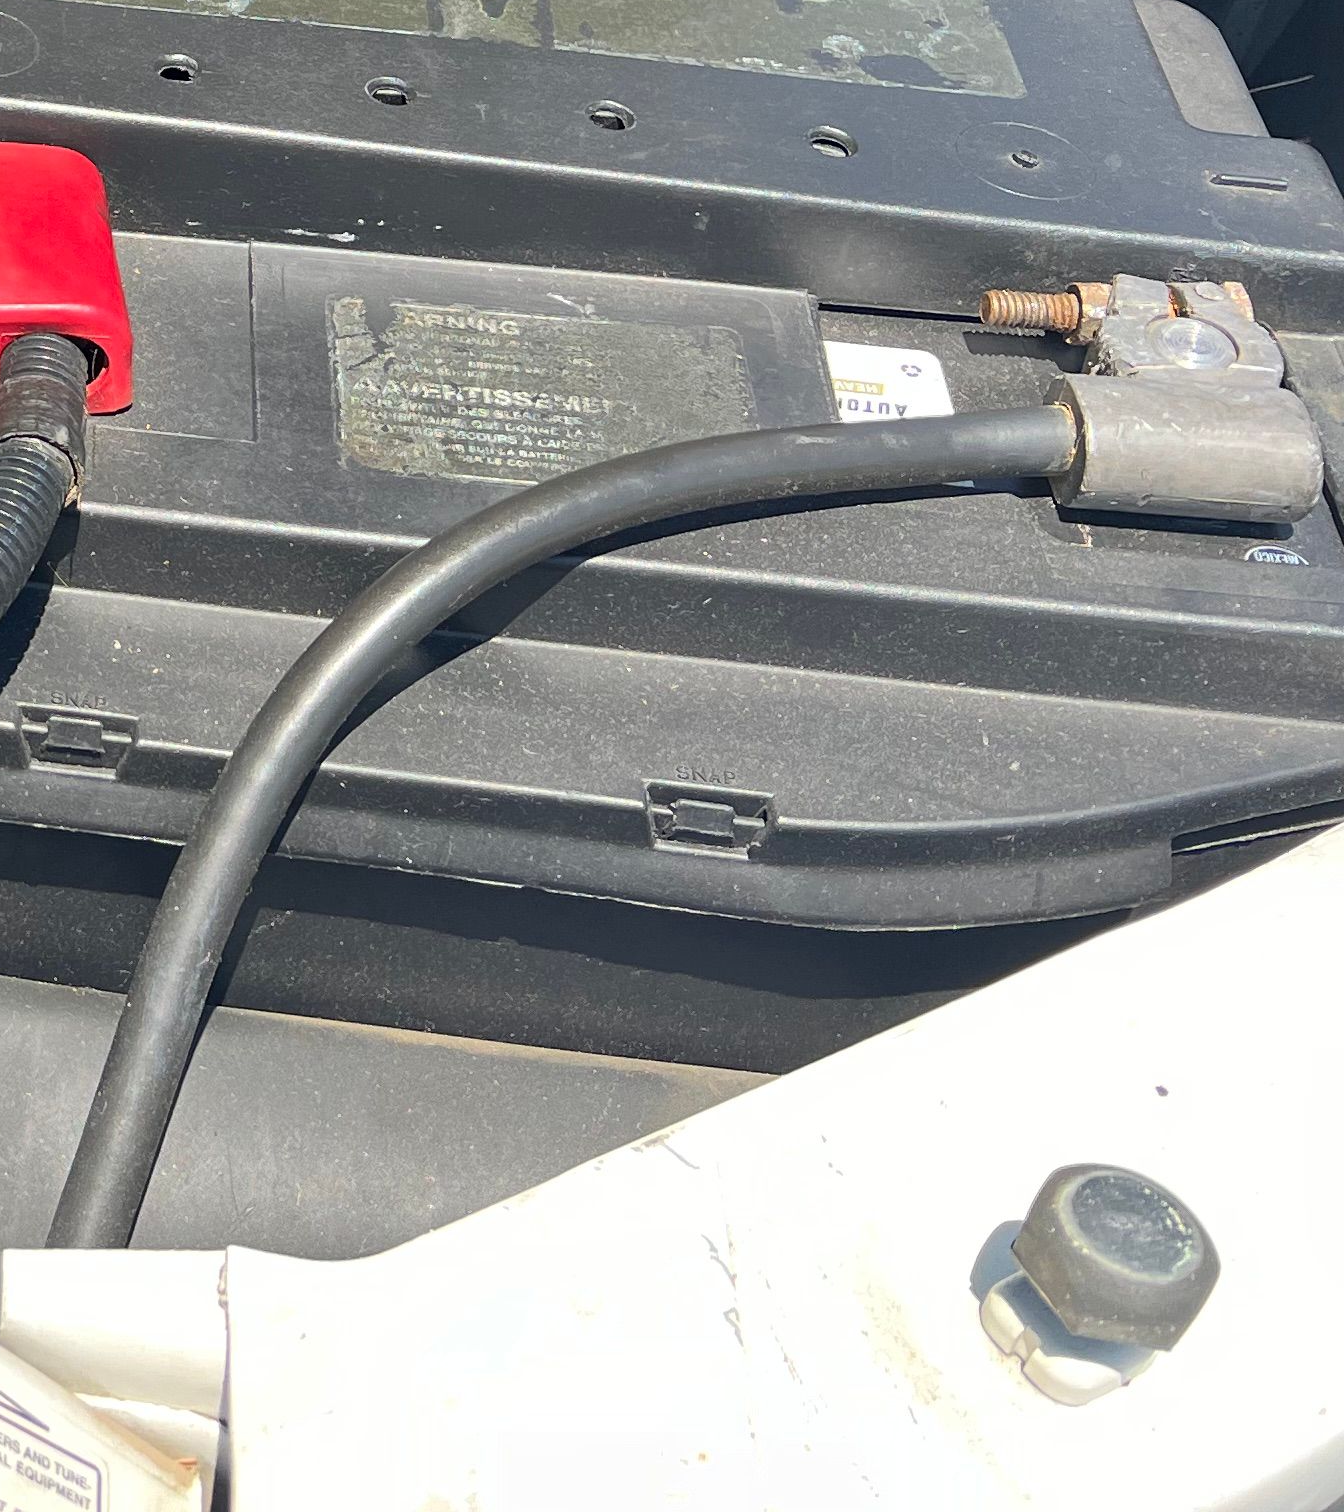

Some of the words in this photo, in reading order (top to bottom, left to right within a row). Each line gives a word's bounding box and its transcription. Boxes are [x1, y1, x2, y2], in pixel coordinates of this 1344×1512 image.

[405, 313, 520, 335] ARNING
[22, 1445, 51, 1471] AND
[14, 1459, 92, 1512] EQUIPMENT
